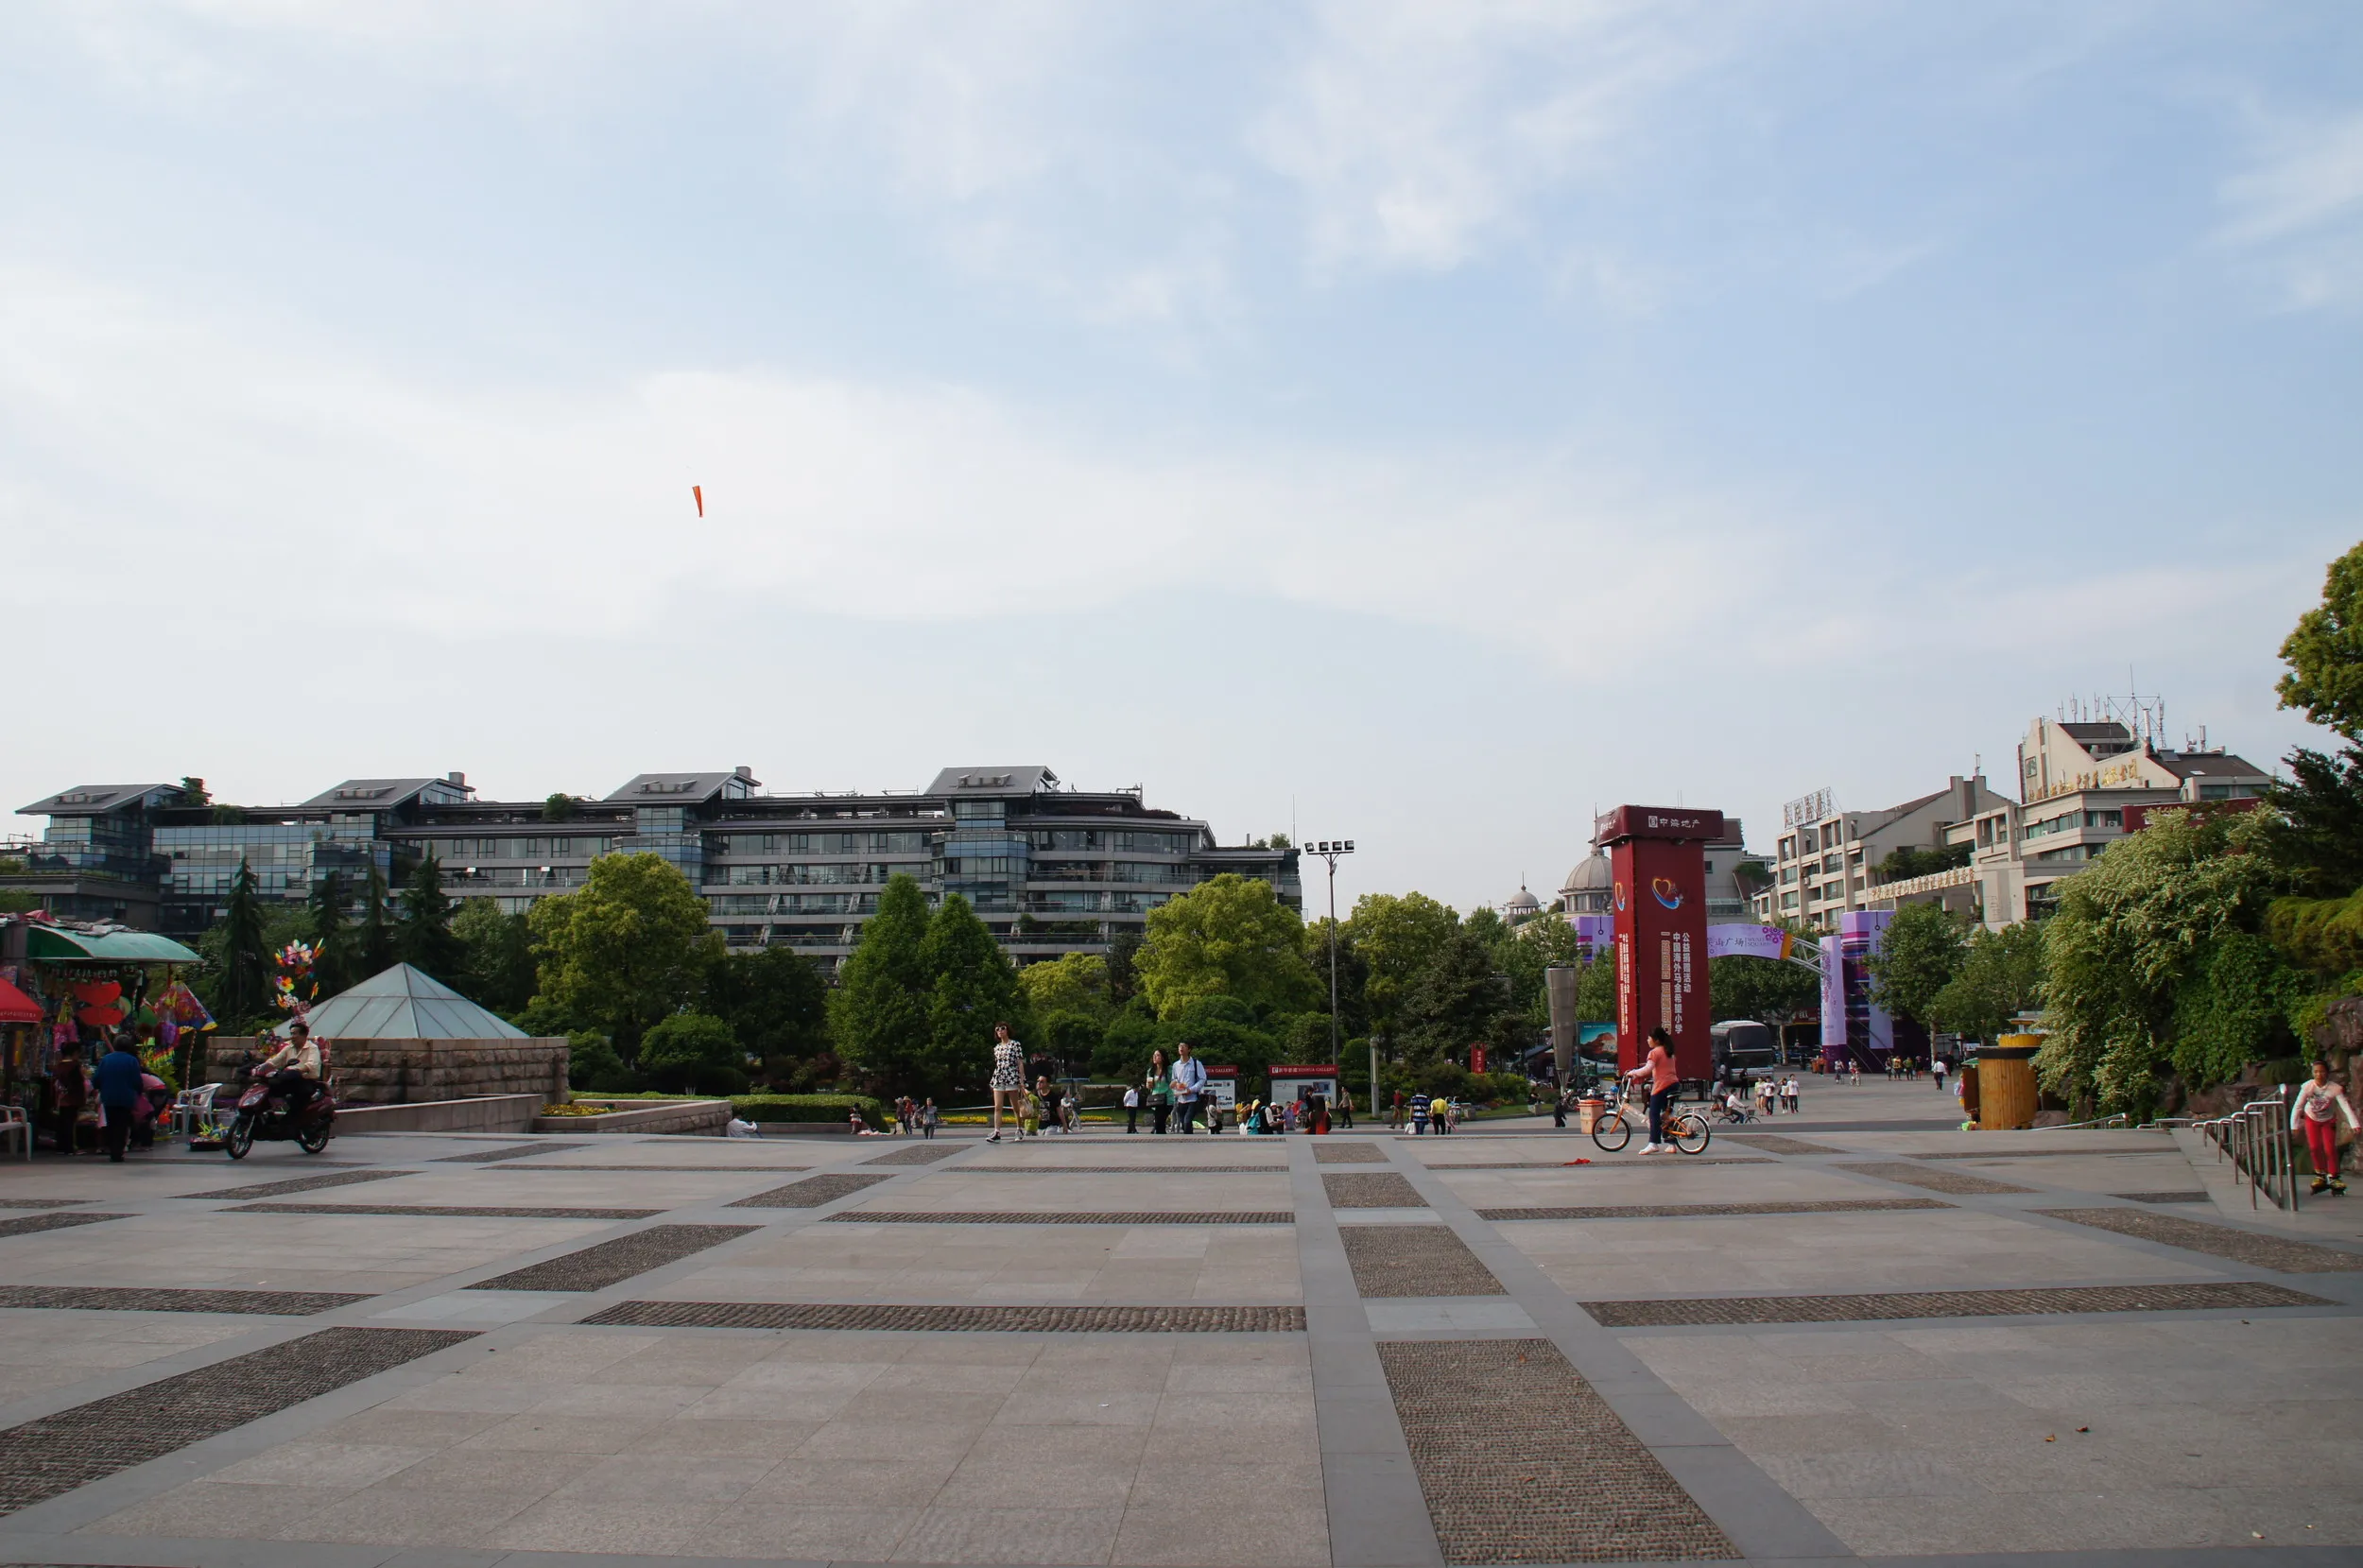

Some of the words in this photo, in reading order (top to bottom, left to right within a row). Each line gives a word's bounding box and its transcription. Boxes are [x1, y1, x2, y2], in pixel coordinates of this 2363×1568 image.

[1660, 818, 1700, 828] 中海地产
[1673, 932, 1683, 1034] 中国海外马金希望小学
[1682, 932, 1691, 992] 公益捐赠活动
